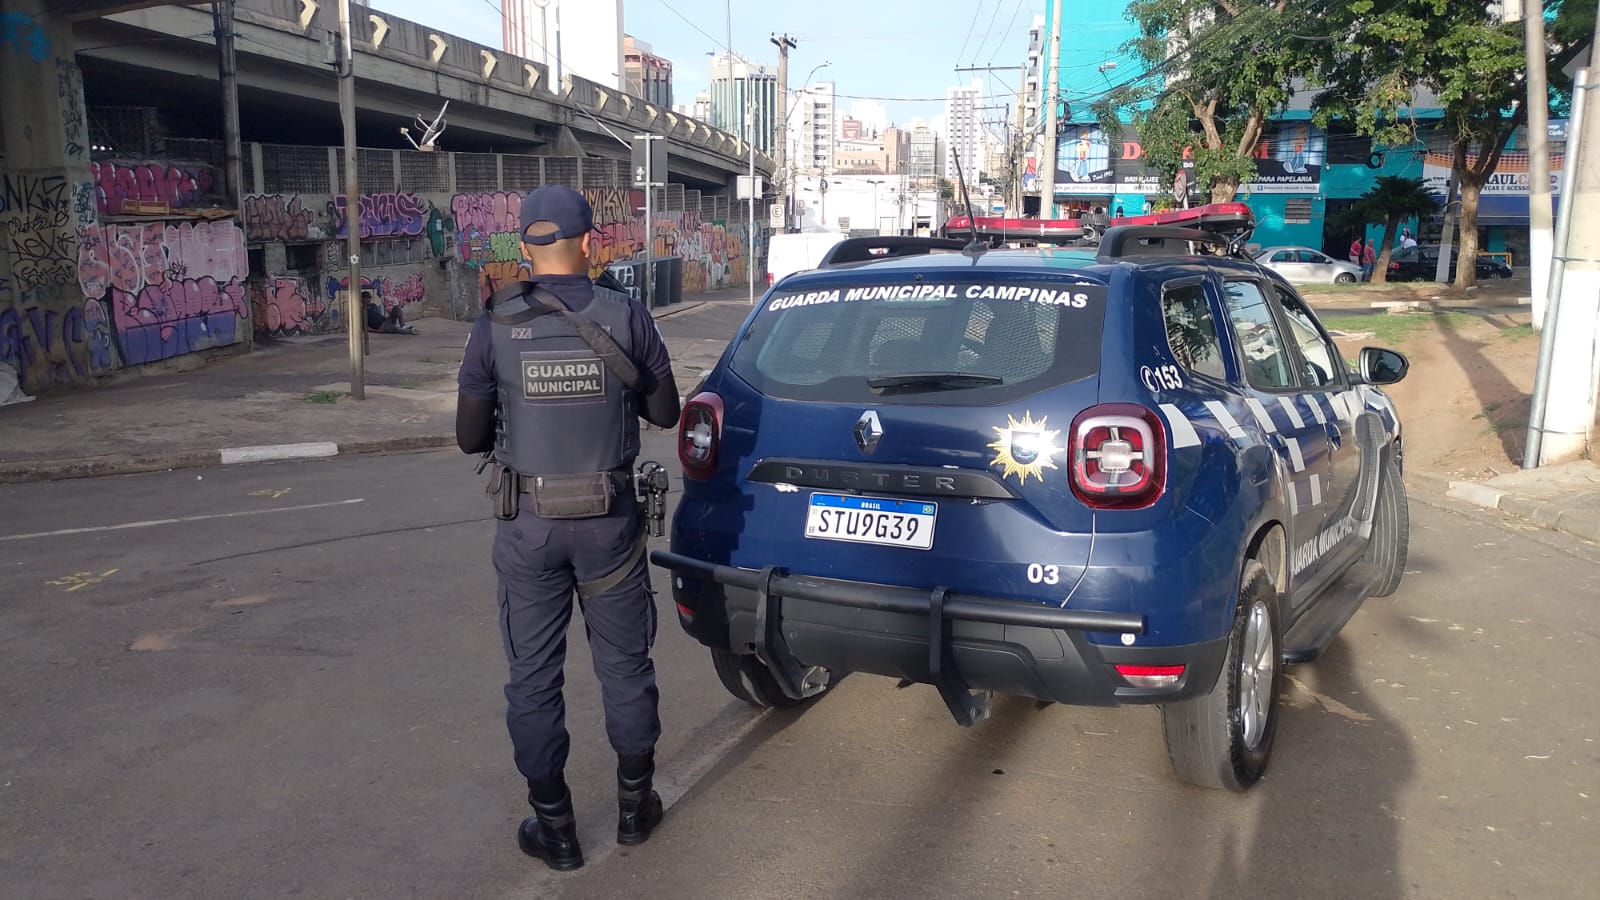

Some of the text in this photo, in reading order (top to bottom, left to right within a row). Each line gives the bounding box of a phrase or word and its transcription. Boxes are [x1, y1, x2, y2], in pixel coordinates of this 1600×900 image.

[768, 285, 1089, 312] GUARDA MUNICIPAL CAMPINAS
[527, 363, 600, 378] GUARDA
[1154, 365, 1183, 390] 153
[527, 380, 601, 393] MUNICIPAL
[784, 466, 956, 492] DUSTER
[861, 501, 881, 511] BRASIL
[817, 509, 919, 541] STU9G39
[1293, 535, 1319, 576] UARDA
[1027, 563, 1060, 585] 03
